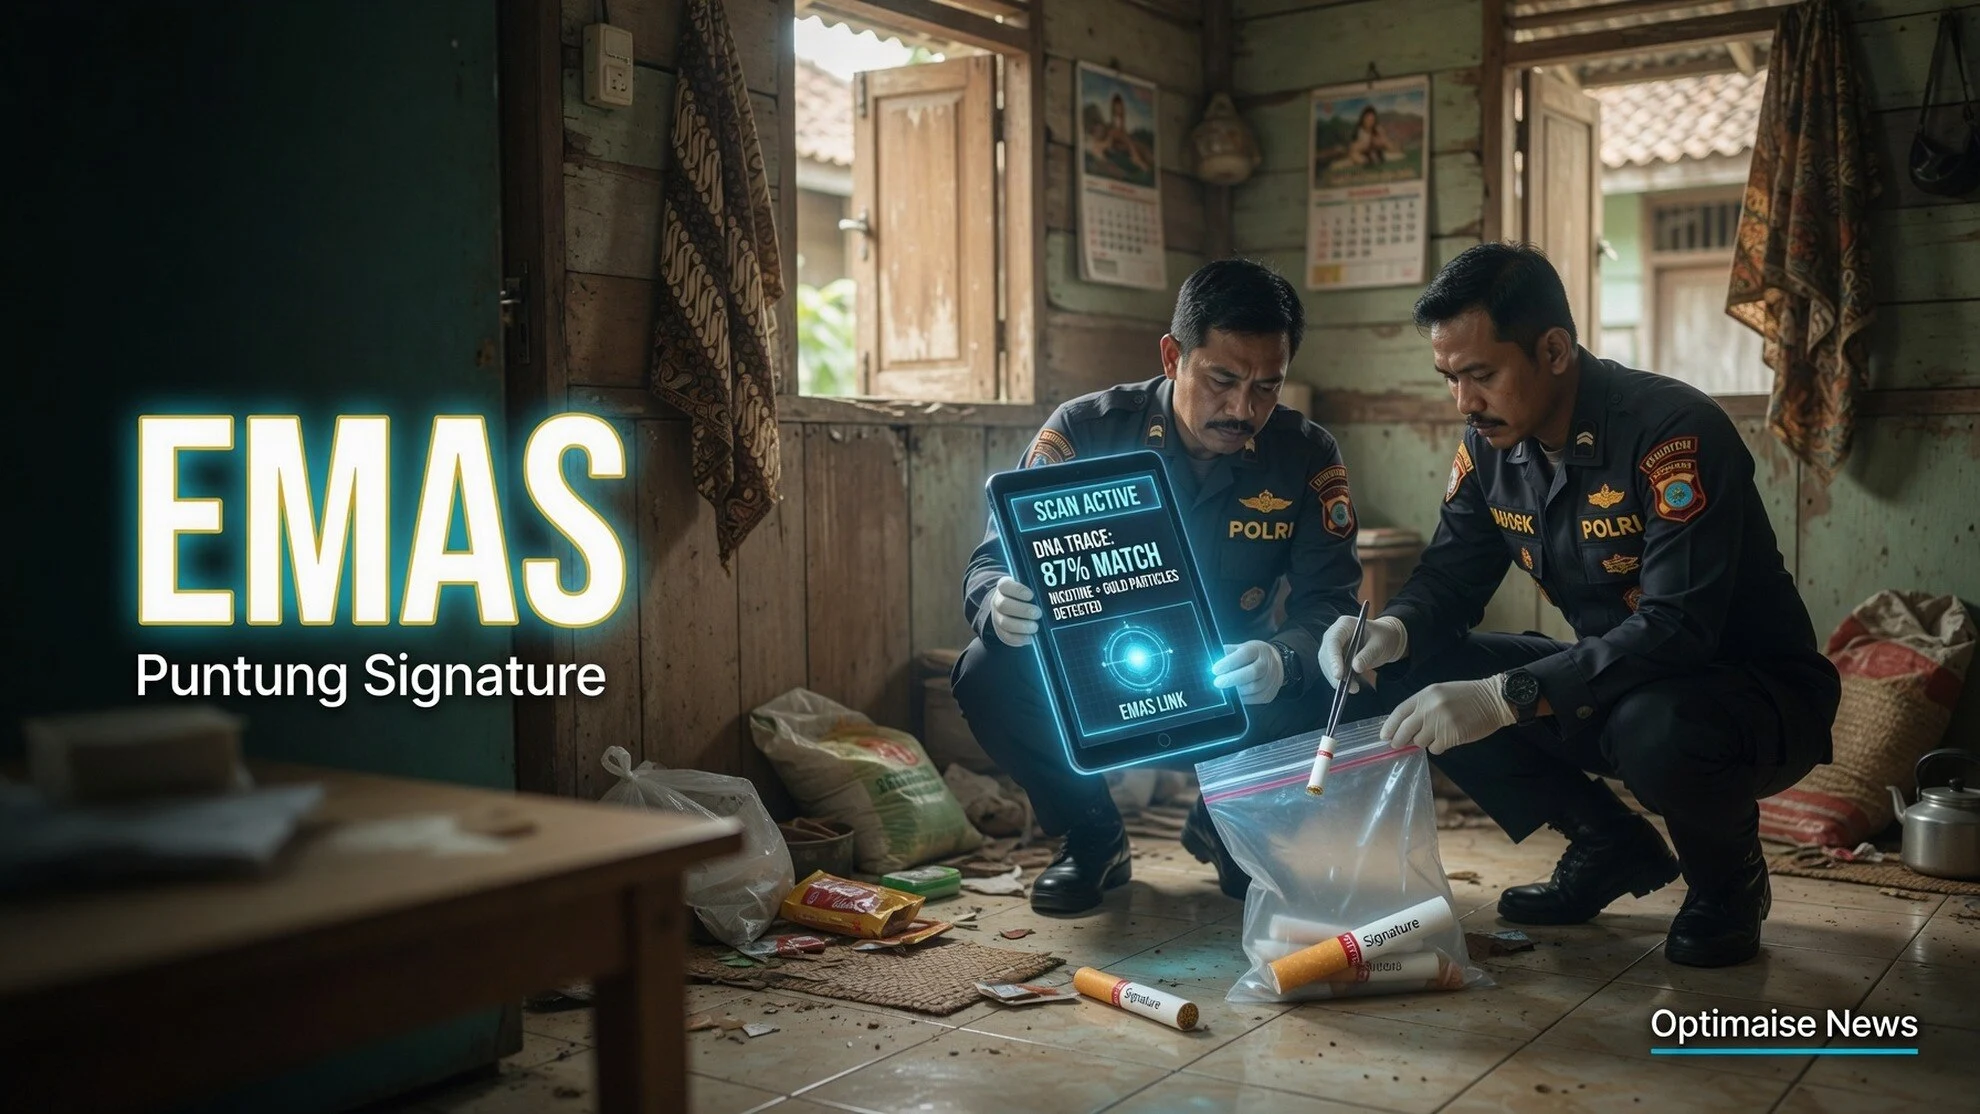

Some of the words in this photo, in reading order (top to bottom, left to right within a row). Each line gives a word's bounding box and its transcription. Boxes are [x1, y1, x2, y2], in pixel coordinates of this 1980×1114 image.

[1033, 496, 1081, 522] SCAN
[1084, 485, 1141, 512] ACTIVE
[1228, 520, 1294, 540] POLRI
[1582, 514, 1643, 540] POLRI
[1032, 537, 1065, 559] DNA
[1063, 528, 1115, 553] TRACE:
[1040, 557, 1091, 587] 87%
[1091, 541, 1163, 578] MATCH
[1118, 699, 1156, 721] EMAS
[1156, 691, 1188, 714] LINK
[1362, 919, 1420, 948] Signature
